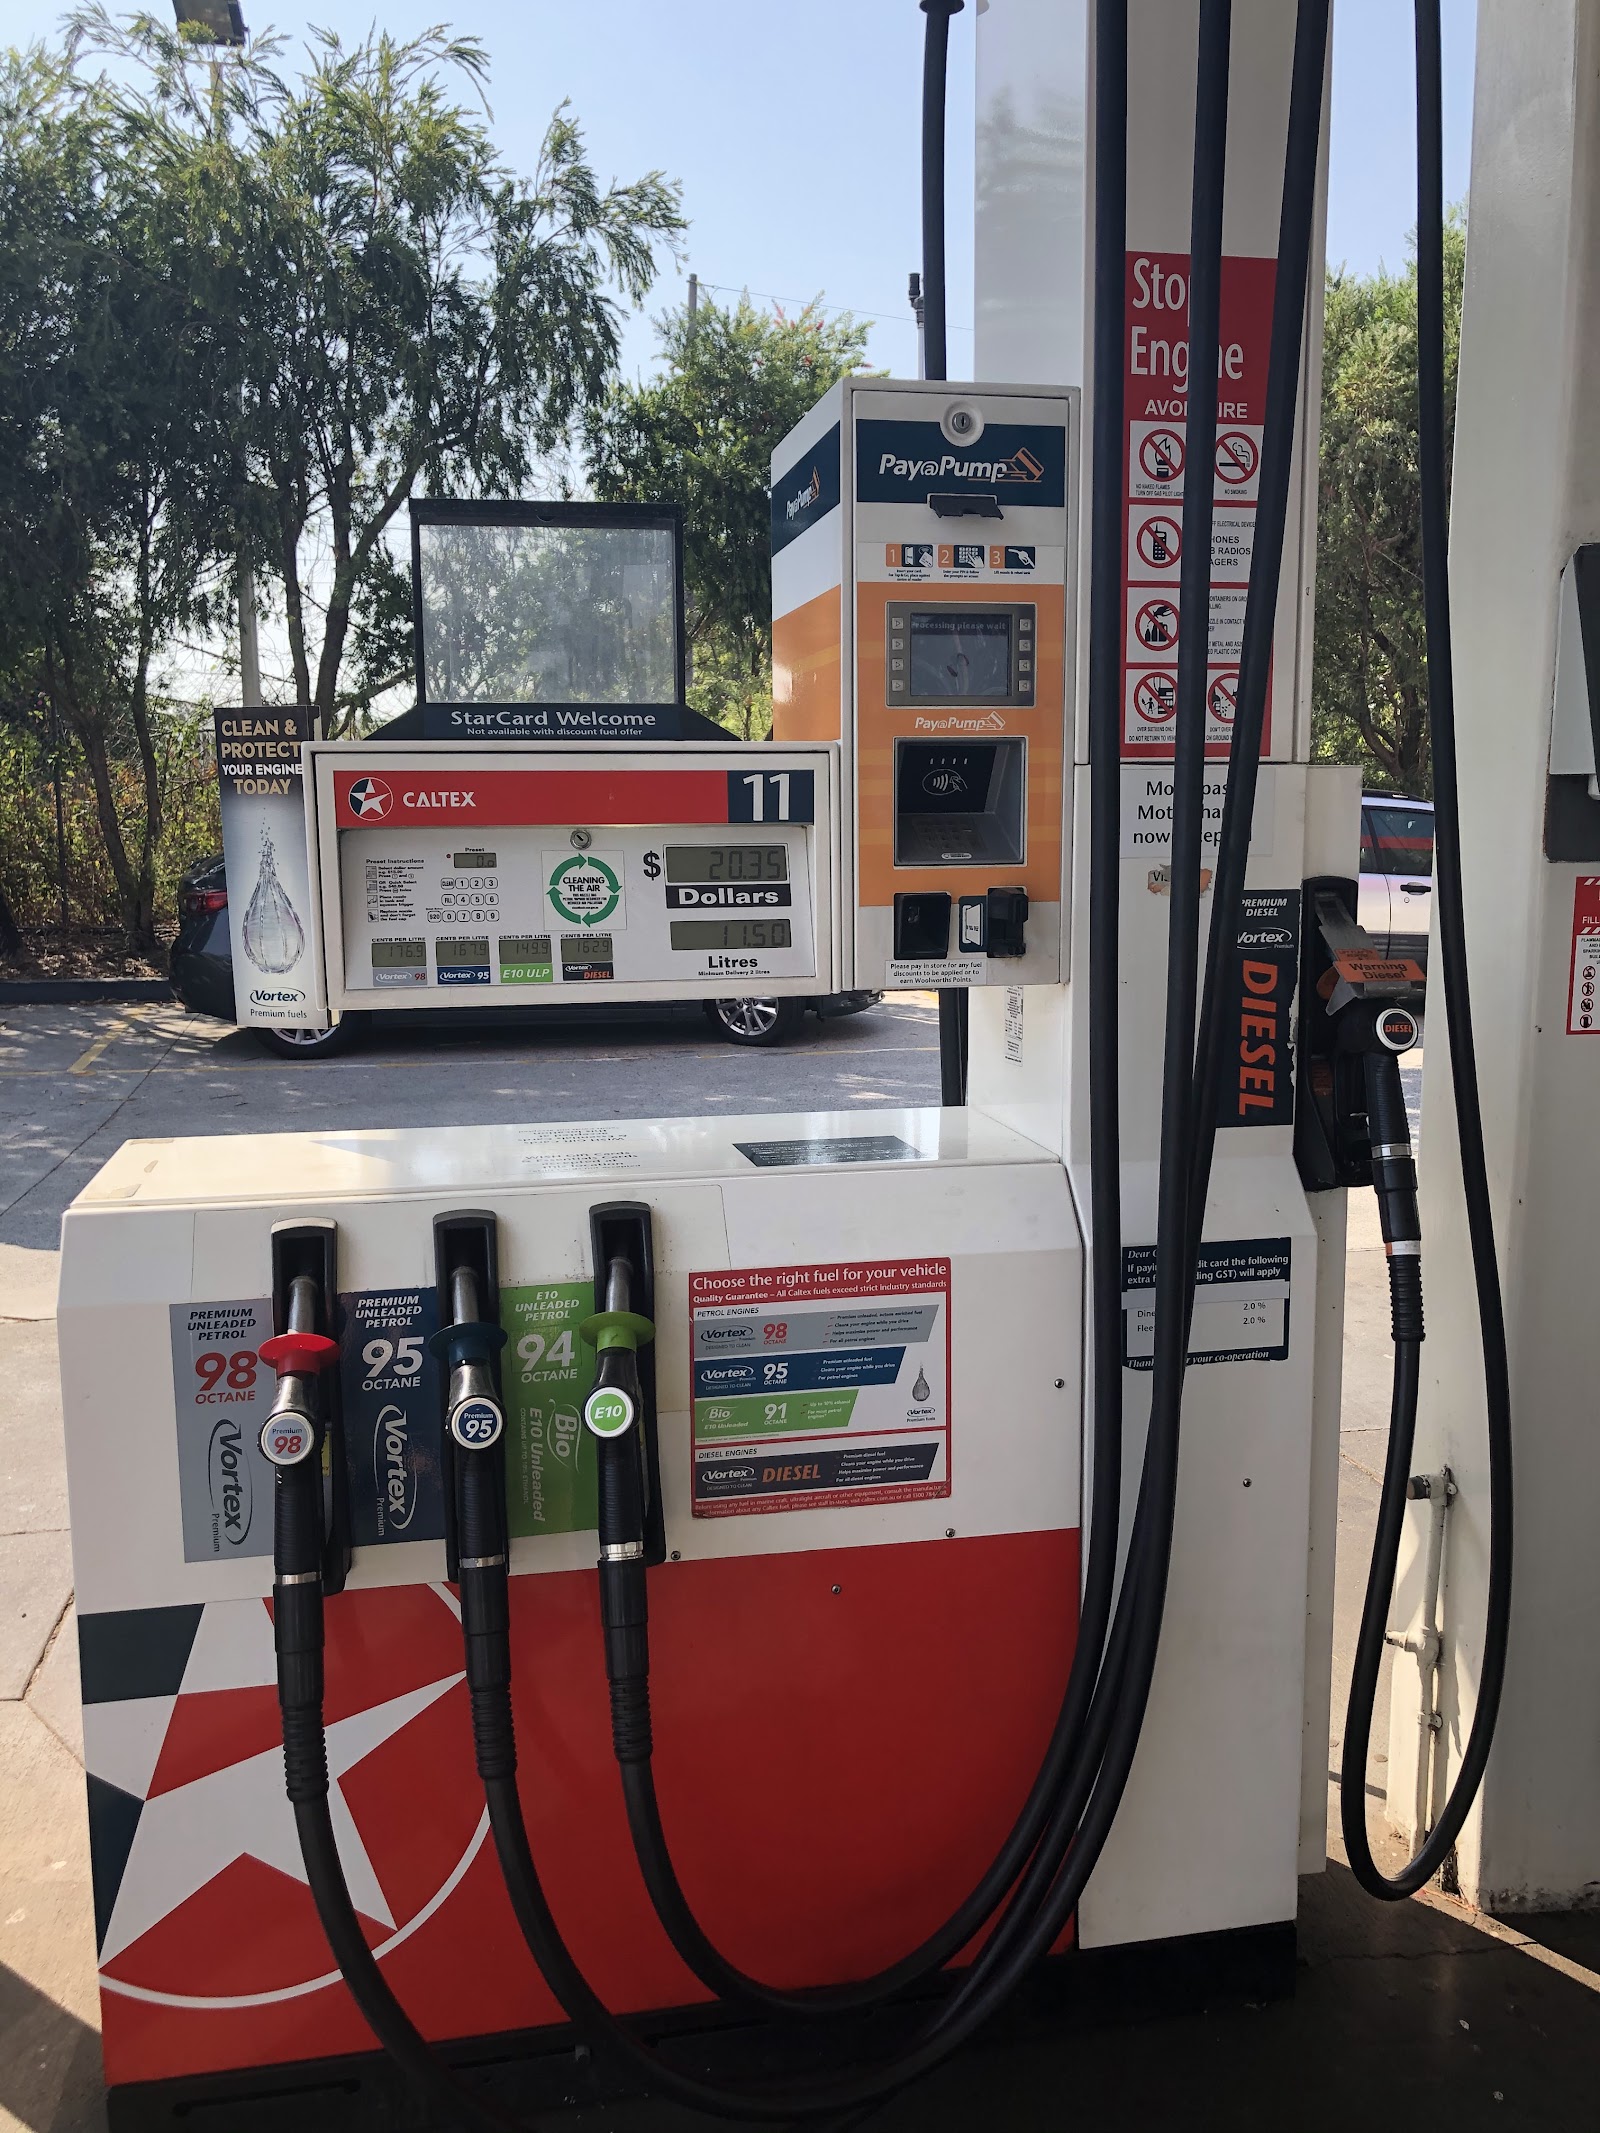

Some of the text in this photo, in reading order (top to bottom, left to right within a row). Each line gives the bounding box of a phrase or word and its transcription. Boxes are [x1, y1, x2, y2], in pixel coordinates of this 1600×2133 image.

[1132, 257, 1191, 327] Sto
[1218, 402, 1248, 419] IRE
[878, 453, 1008, 483] Pay@Pump
[941, 549, 950, 564] 2
[992, 550, 1001, 565] 3
[1218, 547, 1251, 555] RADIOS
[986, 622, 1006, 630] wait
[450, 711, 656, 726] StarCard Welcome
[915, 716, 985, 731] Pay@Pump
[221, 719, 298, 737] CLEAN &
[487, 727, 530, 736] available
[533, 727, 554, 736] with
[556, 728, 597, 736] discount
[600, 728, 617, 736] fuel
[620, 728, 643, 736] offer
[221, 741, 301, 758] PROTECT
[222, 763, 303, 776] YOUR ENGINE
[233, 778, 291, 795] TODAY
[402, 773, 790, 822] CALTEX 11
[1133, 832, 1170, 843] now
[643, 850, 661, 881] $
[708, 850, 781, 880] 20.35
[562, 876, 605, 884] CLEANING
[568, 884, 600, 892] THE AIR
[678, 888, 779, 906] Dollars
[1246, 907, 1279, 917] DIESEL
[708, 955, 758, 968] Litres
[1348, 962, 1409, 973] Warning
[414, 972, 426, 980] 98
[477, 971, 490, 980] 95
[502, 968, 550, 978] E10 ULP
[583, 970, 612, 979] DIESEL
[940, 969, 964, 977] applied
[1362, 971, 1406, 980] Diesel
[253, 989, 299, 1002] Vortex
[250, 1007, 308, 1019] Premium fuels
[1385, 1024, 1412, 1033] DIESEL
[1238, 960, 1278, 1116] DIESEL
[1127, 1250, 1150, 1259] Dear
[1127, 1255, 1289, 1272] If card the following
[693, 1262, 947, 1290] Choose the right fuel for your vehicle
[1127, 1275, 1150, 1284] extra
[1215, 1268, 1238, 1280] GST)
[1239, 1268, 1255, 1277] will
[1256, 1266, 1281, 1278] apply
[536, 1290, 559, 1301] E10
[693, 1279, 947, 1303] Quality Guarantee All Caltex fuels exceed strict industry standards
[358, 1295, 419, 1308] PREMIUM
[514, 1299, 580, 1313] UNLEADED
[1243, 1302, 1256, 1311] 2.0
[189, 1308, 253, 1320] PREMIUM
[355, 1305, 423, 1319] UNLEADED
[524, 1310, 570, 1322] PETROL
[697, 1306, 759, 1318] PETROL ENGINES
[187, 1318, 257, 1331] UNLEADED
[365, 1316, 413, 1328] PETROL
[1243, 1317, 1256, 1325] 2.0
[198, 1329, 247, 1341] PETROL
[706, 1322, 788, 1339] Vortex 98
[763, 1338, 787, 1346] OCTANE
[361, 1336, 424, 1378] 95
[516, 1330, 576, 1372] 94
[1192, 1351, 1269, 1365] your co-operation
[194, 1350, 258, 1391] 98
[520, 1368, 578, 1384] OCTANE
[706, 1368, 747, 1379] Vortex
[763, 1362, 789, 1380] 95
[361, 1376, 421, 1392] OCTANE
[763, 1378, 788, 1386] OCTANE
[194, 1390, 256, 1405] OCTANE
[594, 1404, 622, 1419] E10
[708, 1407, 731, 1419] Bio
[764, 1403, 788, 1419] 91
[465, 1419, 493, 1439] 95
[717, 1421, 749, 1430] Unleaded
[764, 1418, 787, 1426] OCTANE
[555, 1413, 578, 1458] Bio
[273, 1436, 302, 1454] 98
[698, 1448, 758, 1459] DIESEL ENGINES
[384, 1409, 408, 1515] Vortex
[529, 1407, 546, 1522] E10 Unleaded
[217, 1423, 244, 1531] Vortex
[706, 1464, 821, 1483] Vortex DIESEL
[376, 1496, 386, 1536] Premium
[211, 1513, 220, 1553] Premium
